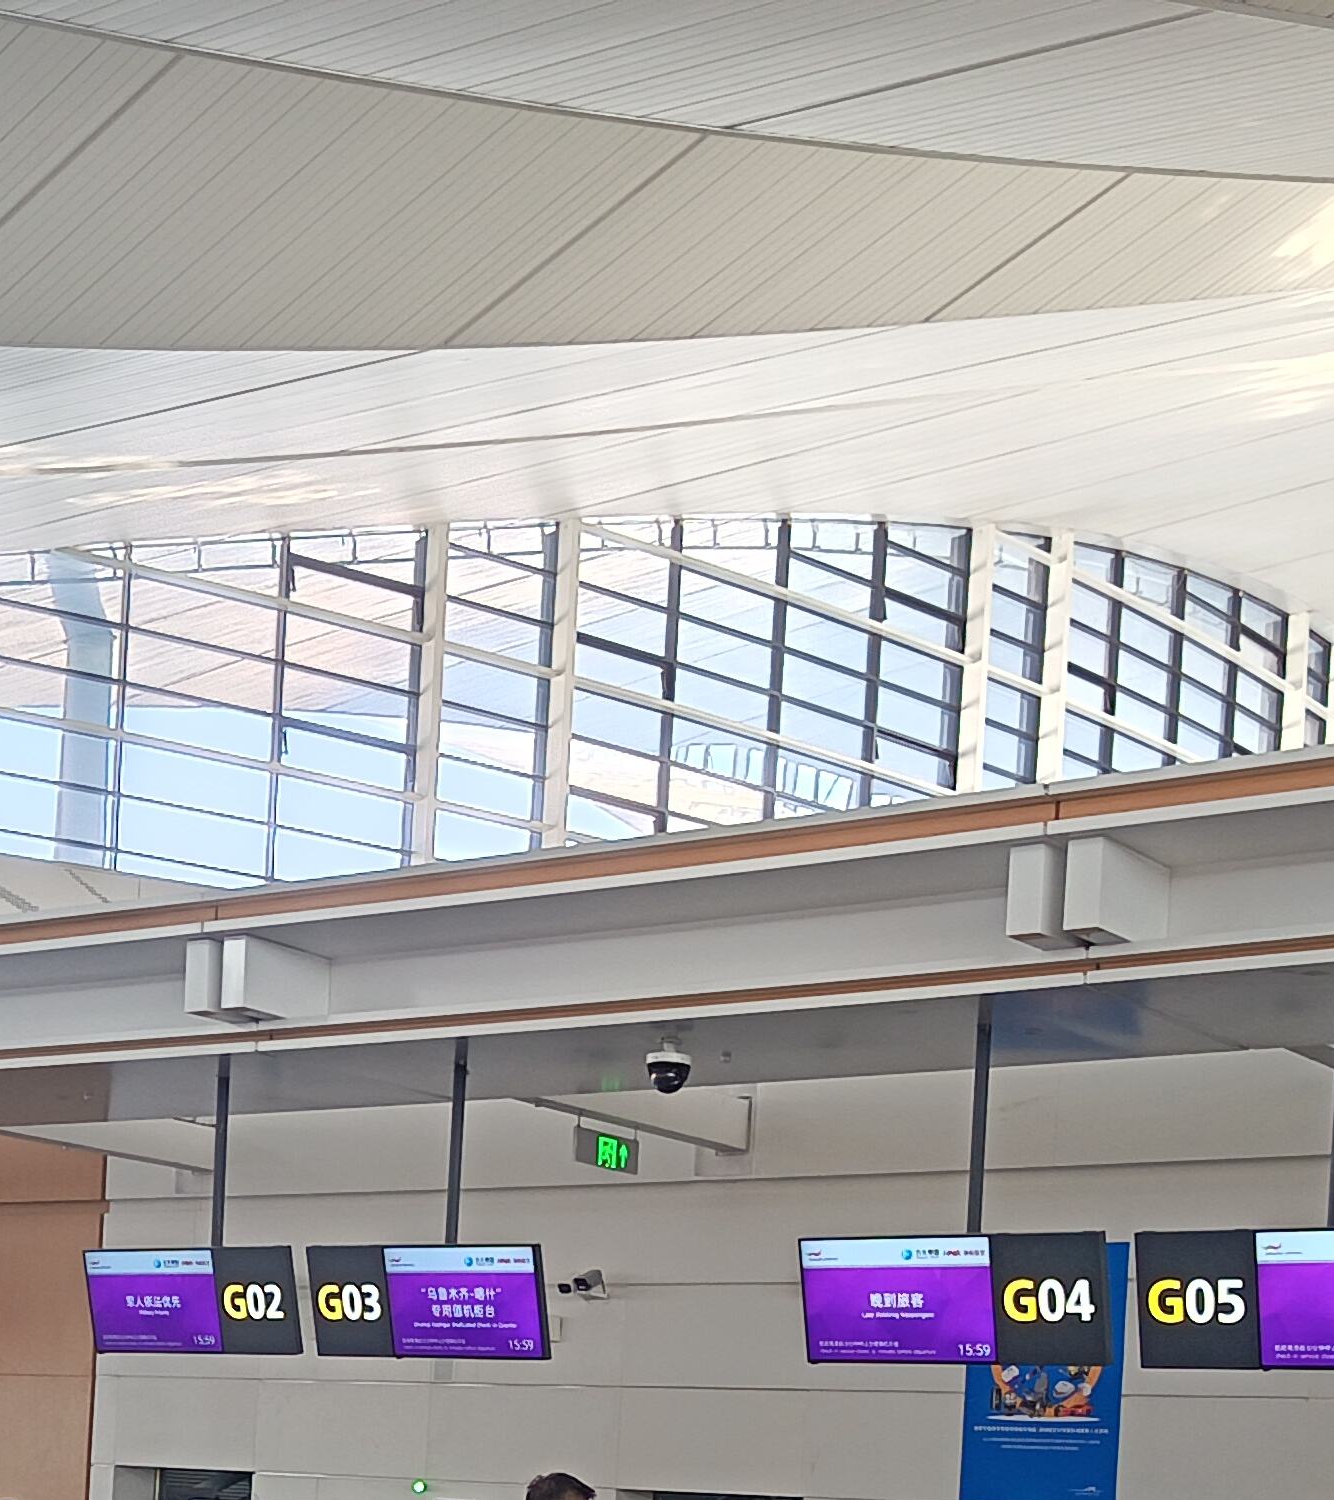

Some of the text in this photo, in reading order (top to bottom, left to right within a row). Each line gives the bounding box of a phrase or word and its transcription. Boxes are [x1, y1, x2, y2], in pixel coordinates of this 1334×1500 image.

[223, 1283, 285, 1320] G02
[318, 1284, 382, 1321] G03
[870, 1293, 924, 1309] 晚到旅客
[1003, 1278, 1095, 1322] G04
[1148, 1277, 1246, 1324] G05
[508, 1339, 534, 1351] 15:59
[958, 1343, 991, 1357] 15:59
